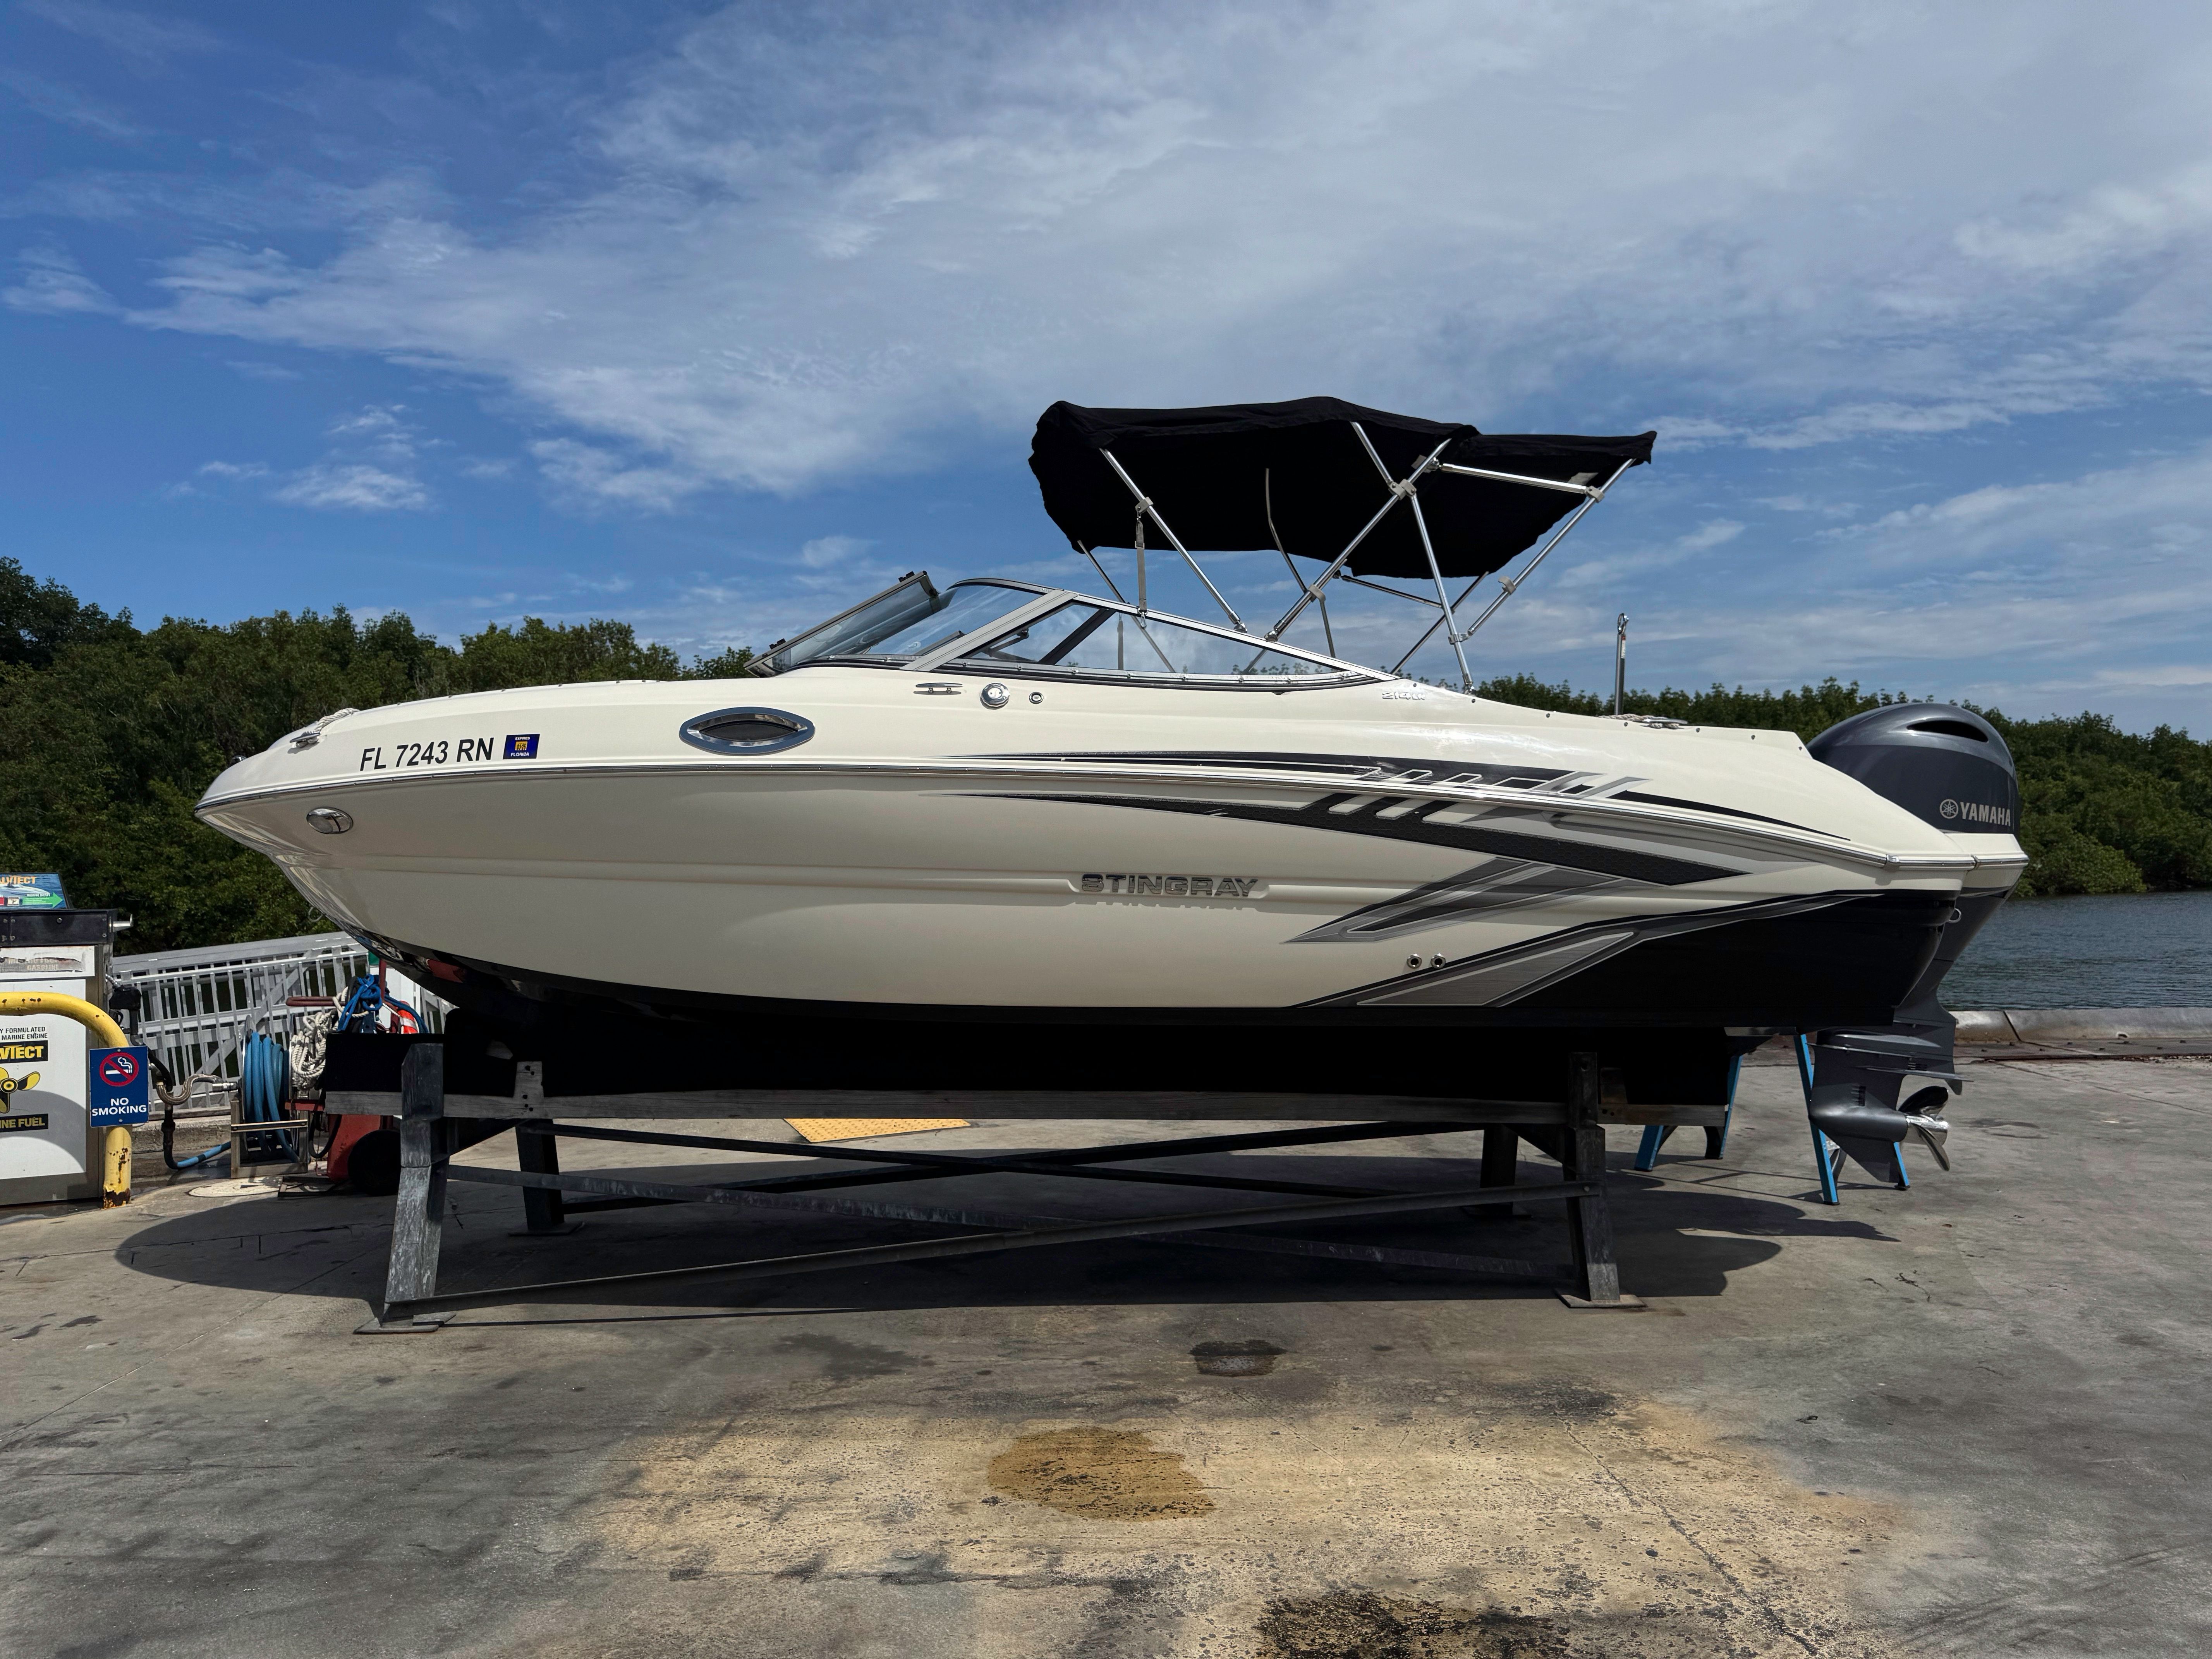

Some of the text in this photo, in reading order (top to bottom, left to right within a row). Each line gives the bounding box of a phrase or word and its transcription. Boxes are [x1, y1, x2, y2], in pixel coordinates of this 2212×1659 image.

[360, 737, 494, 771] FL 7243 RN
[1960, 802, 2011, 826] YAMAHA
[0, 876, 37, 884] LVTECT
[1082, 873, 1258, 897] STINGRAY
[0, 1045, 44, 1060] VTECT
[111, 1097, 129, 1106] NO
[92, 1105, 147, 1116] SMOKING
[18, 1117, 45, 1127] FUEL
